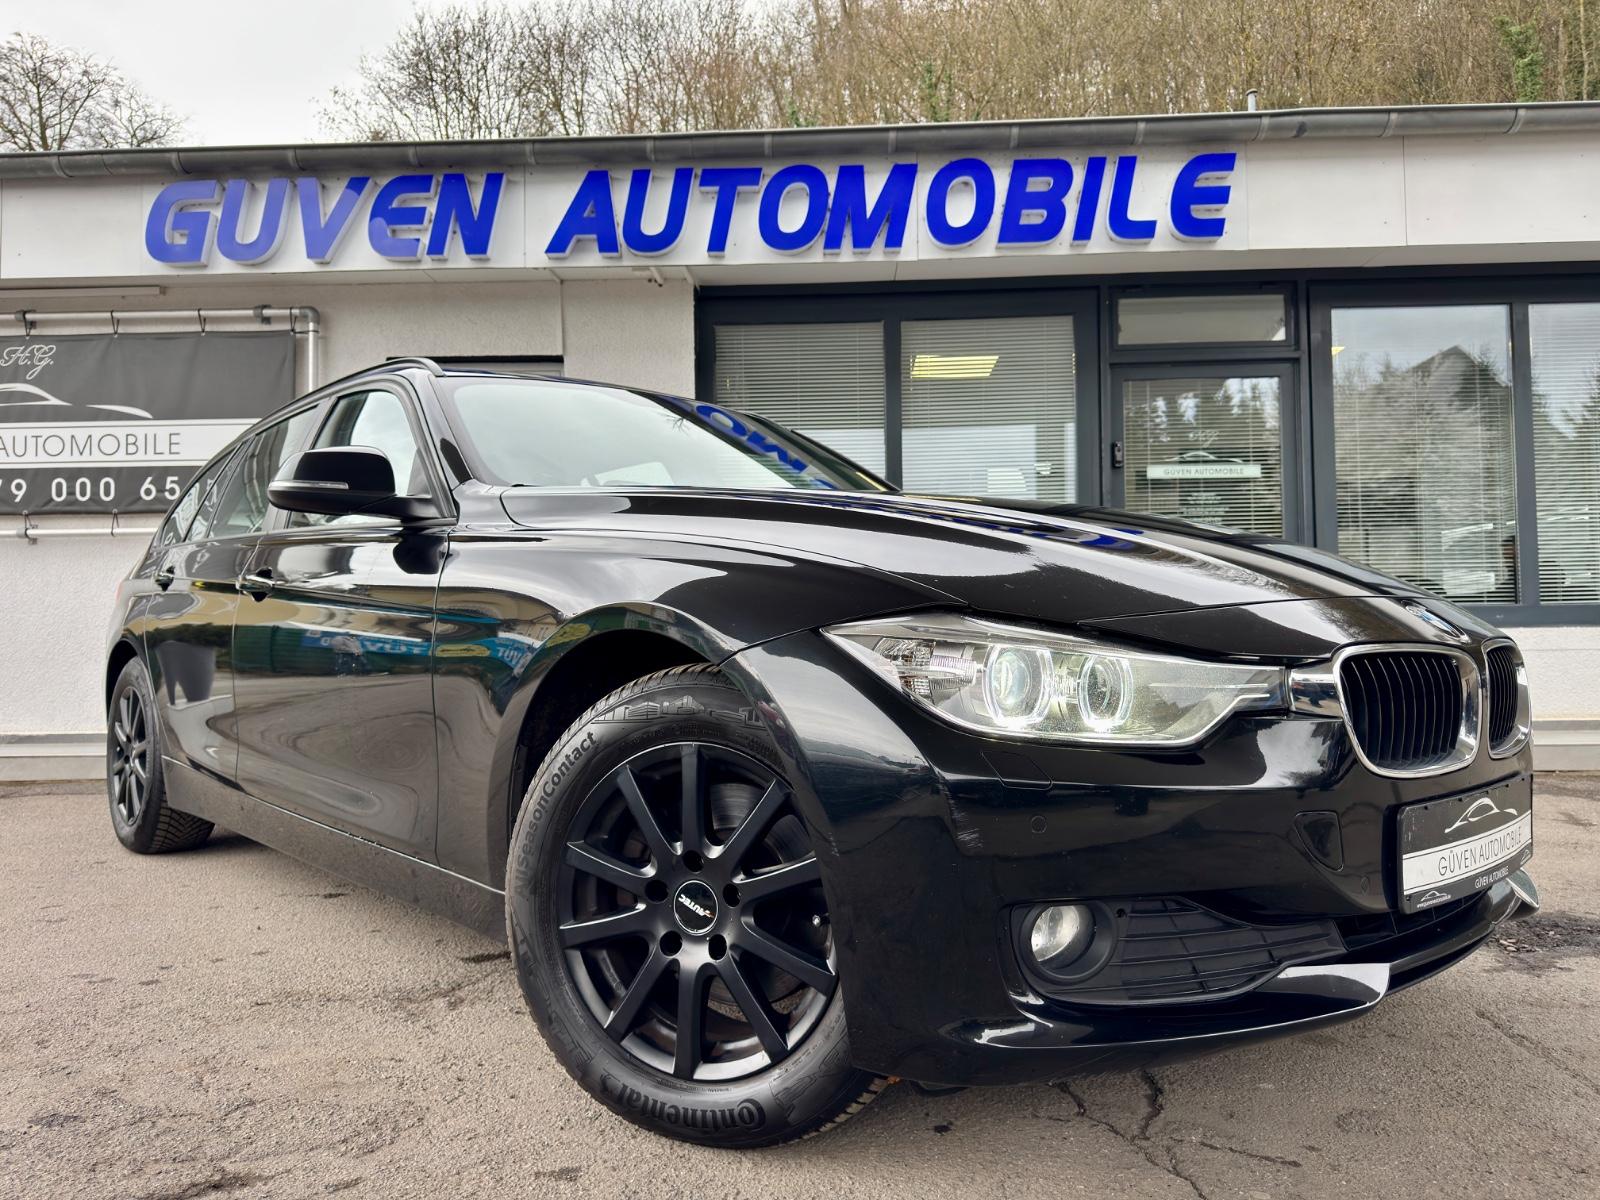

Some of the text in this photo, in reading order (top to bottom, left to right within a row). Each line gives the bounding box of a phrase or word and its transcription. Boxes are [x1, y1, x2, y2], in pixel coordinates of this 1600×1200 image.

[145, 152, 1237, 265] GUVEN AUTOMOBILE
[51, 477, 116, 502] 000
[139, 475, 182, 501] 65
[1194, 467, 1245, 476] AUTOMOBILE
[1438, 826, 1521, 876] GÜVEN AUTOMOBILE
[619, 1083, 767, 1132] Continental
